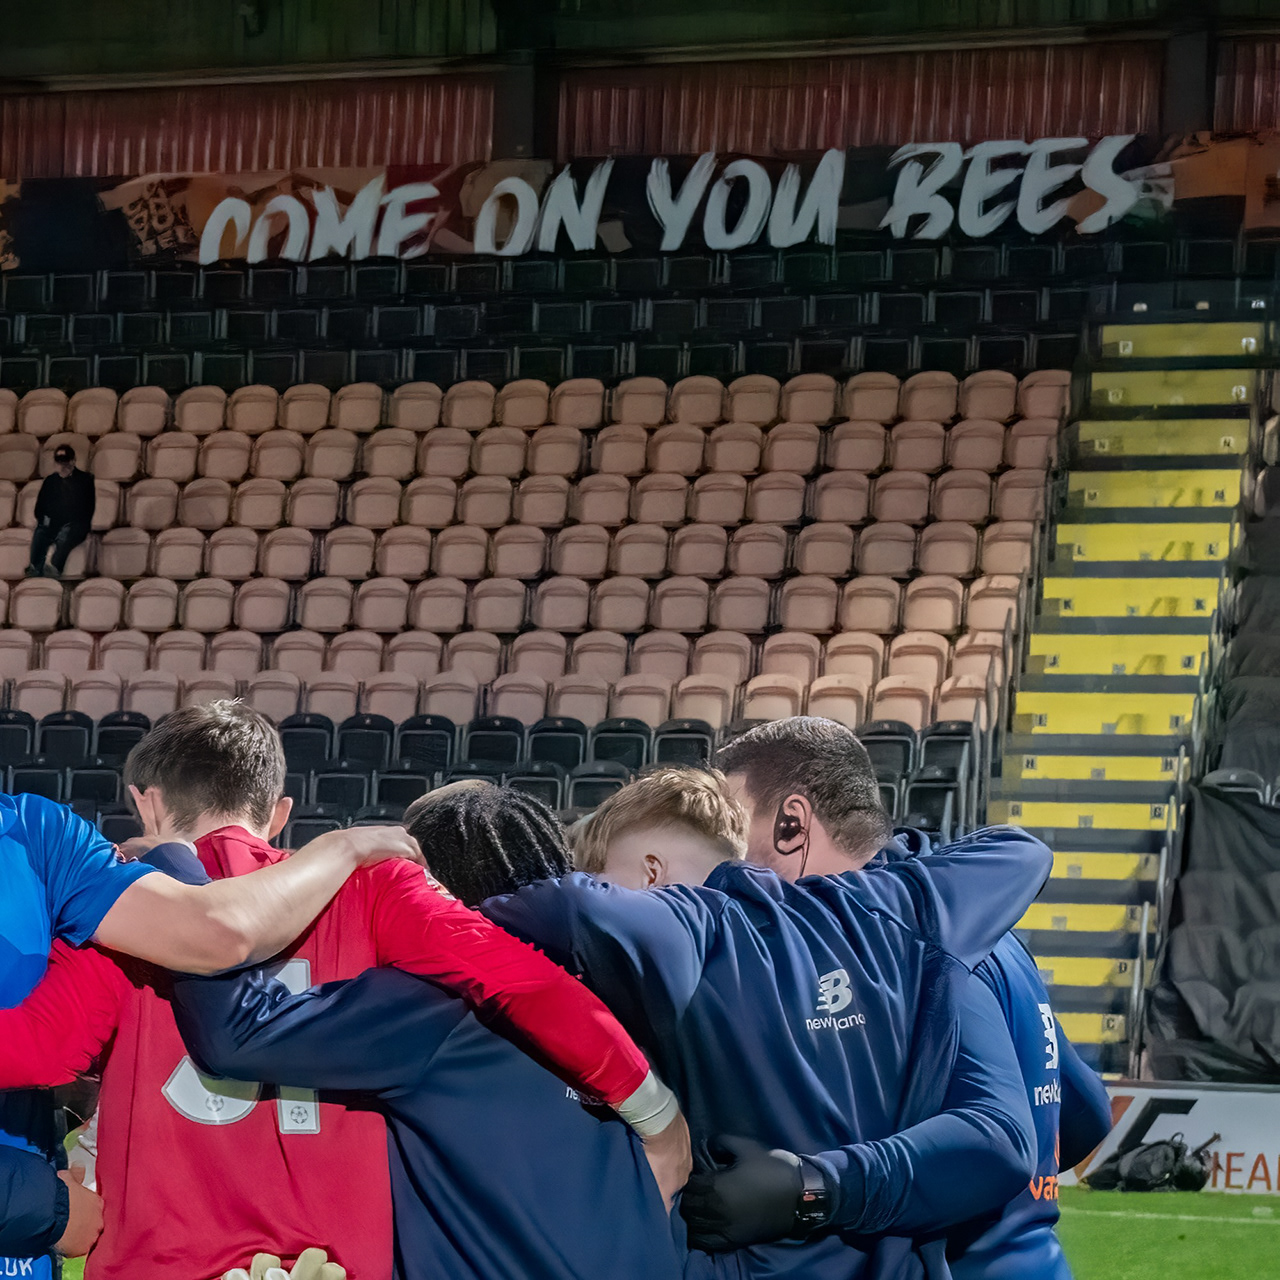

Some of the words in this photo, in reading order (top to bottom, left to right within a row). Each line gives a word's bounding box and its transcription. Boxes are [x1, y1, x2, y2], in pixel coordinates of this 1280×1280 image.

[474, 157, 614, 258] ON
[646, 148, 845, 252] YOU
[878, 133, 1140, 240] BEES
